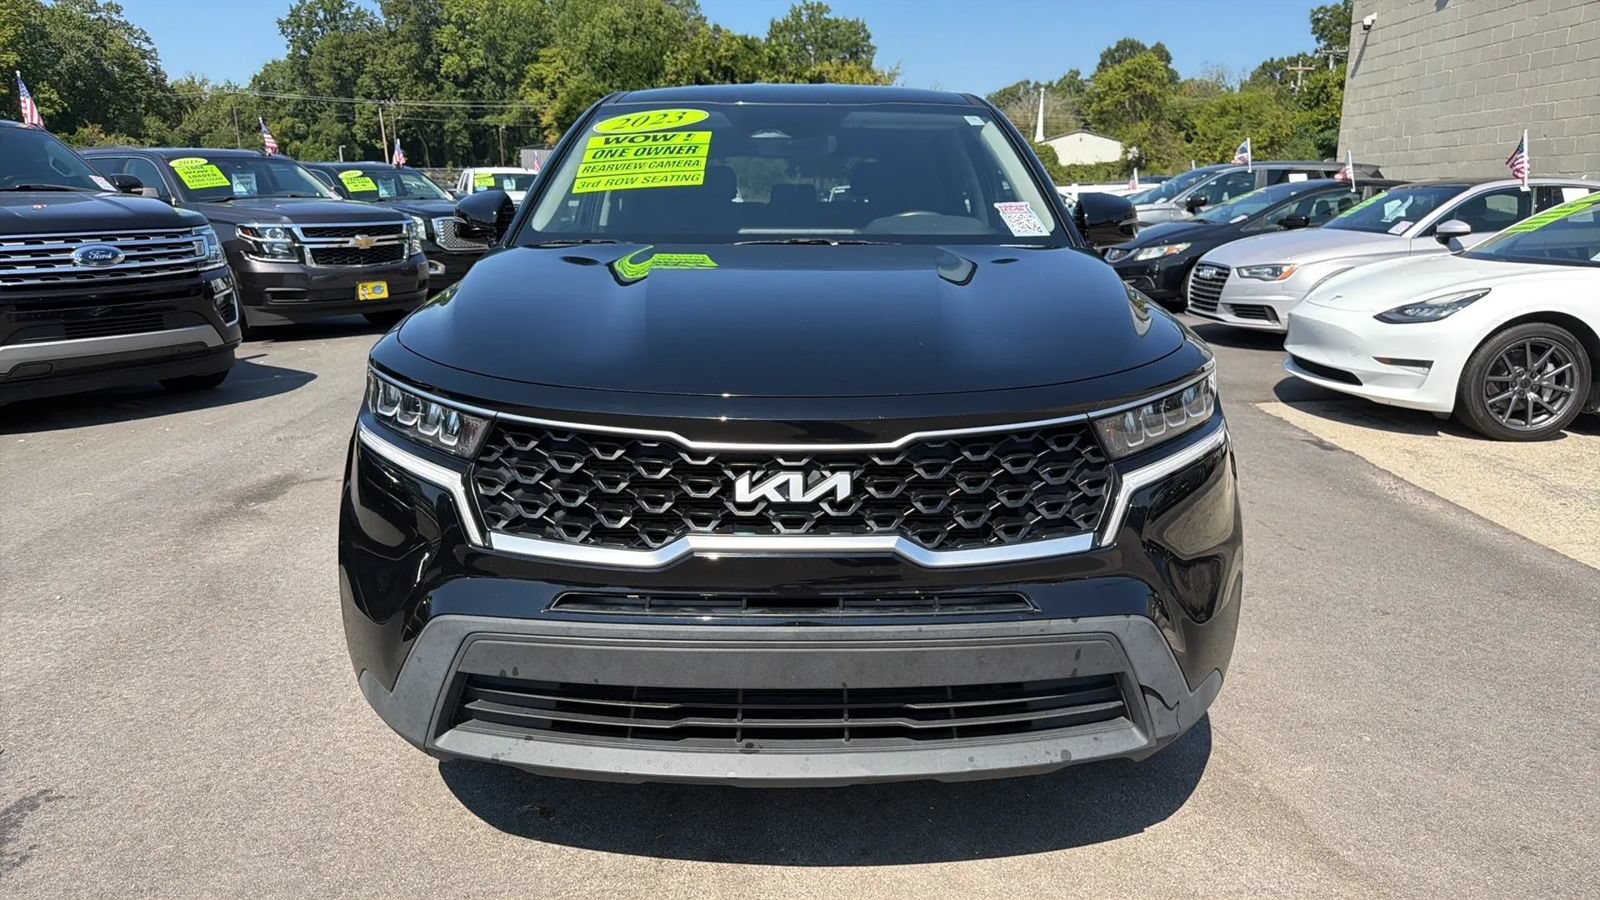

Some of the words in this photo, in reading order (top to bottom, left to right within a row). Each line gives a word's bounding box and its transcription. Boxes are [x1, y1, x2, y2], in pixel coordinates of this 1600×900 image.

[611, 112, 688, 131] 2023
[603, 133, 679, 146] WOW
[592, 148, 630, 160] ONE
[633, 145, 700, 157] OWNER
[582, 161, 646, 174] REARVIEW
[648, 159, 700, 170] CAMERA
[577, 179, 601, 190] 3rd
[605, 177, 639, 187] ROW
[641, 173, 701, 185] SEATING
[88, 250, 113, 260] Ford
